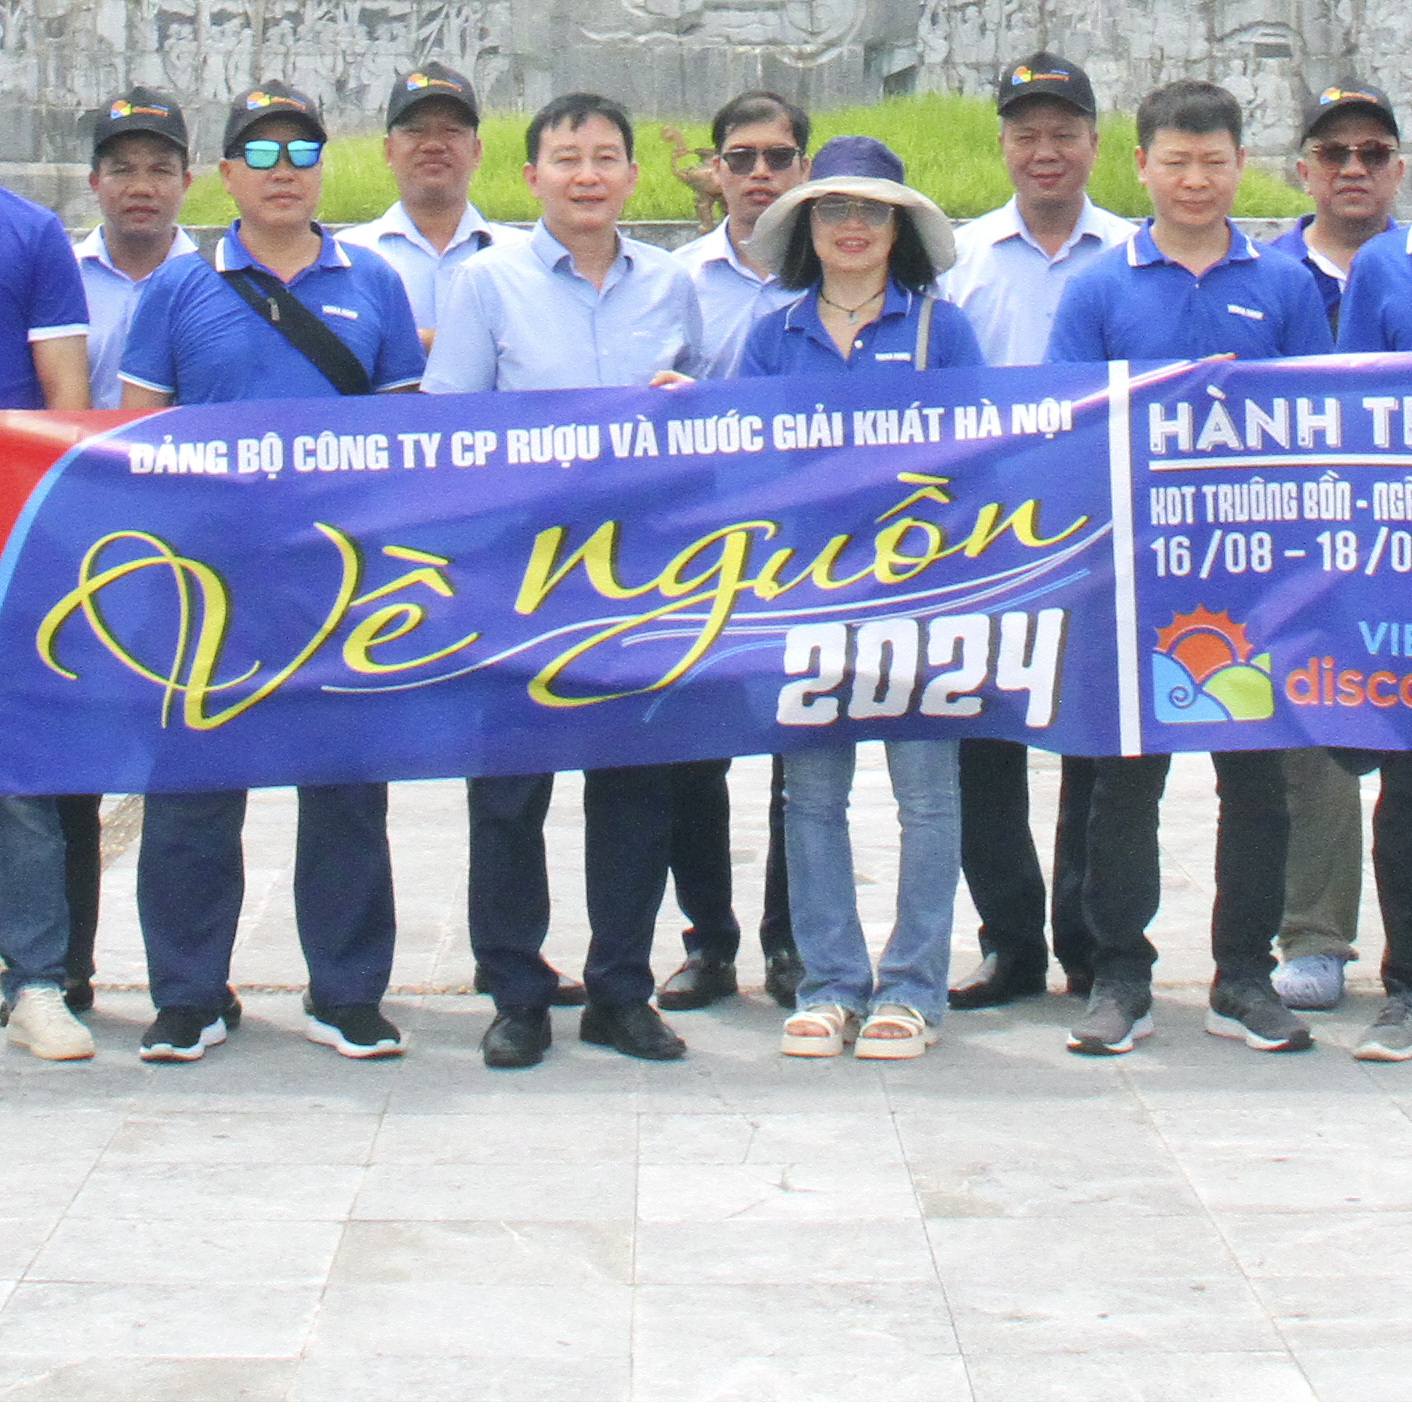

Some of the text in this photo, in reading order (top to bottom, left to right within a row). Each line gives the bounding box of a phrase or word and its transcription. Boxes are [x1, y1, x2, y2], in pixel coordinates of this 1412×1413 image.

[129, 398, 1073, 479] ĐẢNG BỘ CÔNG TY CP RƯỢU VÀ NƯỚC GIẢI KHÁT HÀ NỘI
[1148, 385, 1342, 454] HÀNH
[1201, 475, 1298, 523] TRUÔNG
[1302, 469, 1351, 521] BỒN
[36, 522, 480, 731] Về
[776, 608, 1064, 728] 2024
